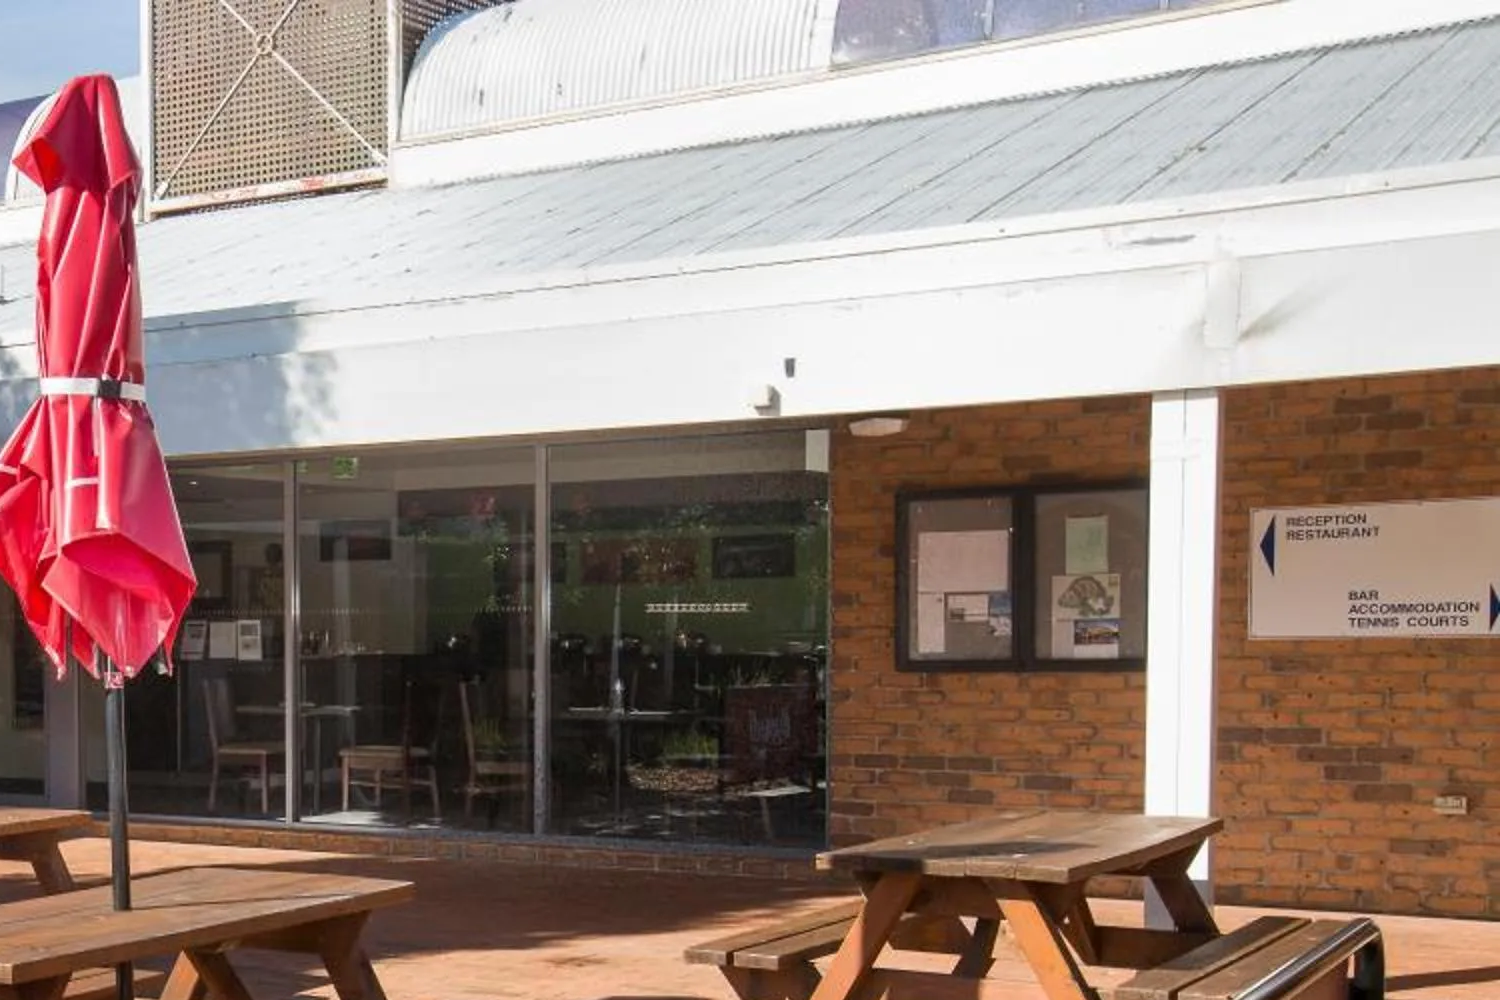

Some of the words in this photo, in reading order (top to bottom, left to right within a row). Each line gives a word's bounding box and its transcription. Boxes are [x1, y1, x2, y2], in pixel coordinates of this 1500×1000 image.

[1285, 513, 1368, 527] RECEPTION
[1285, 526, 1381, 541] RESTAURANT
[1347, 590, 1380, 601] BAR
[1347, 601, 1481, 615] ACCOMMODATION
[1347, 616, 1400, 629] TENNIS
[1406, 615, 1470, 628] COURTS
